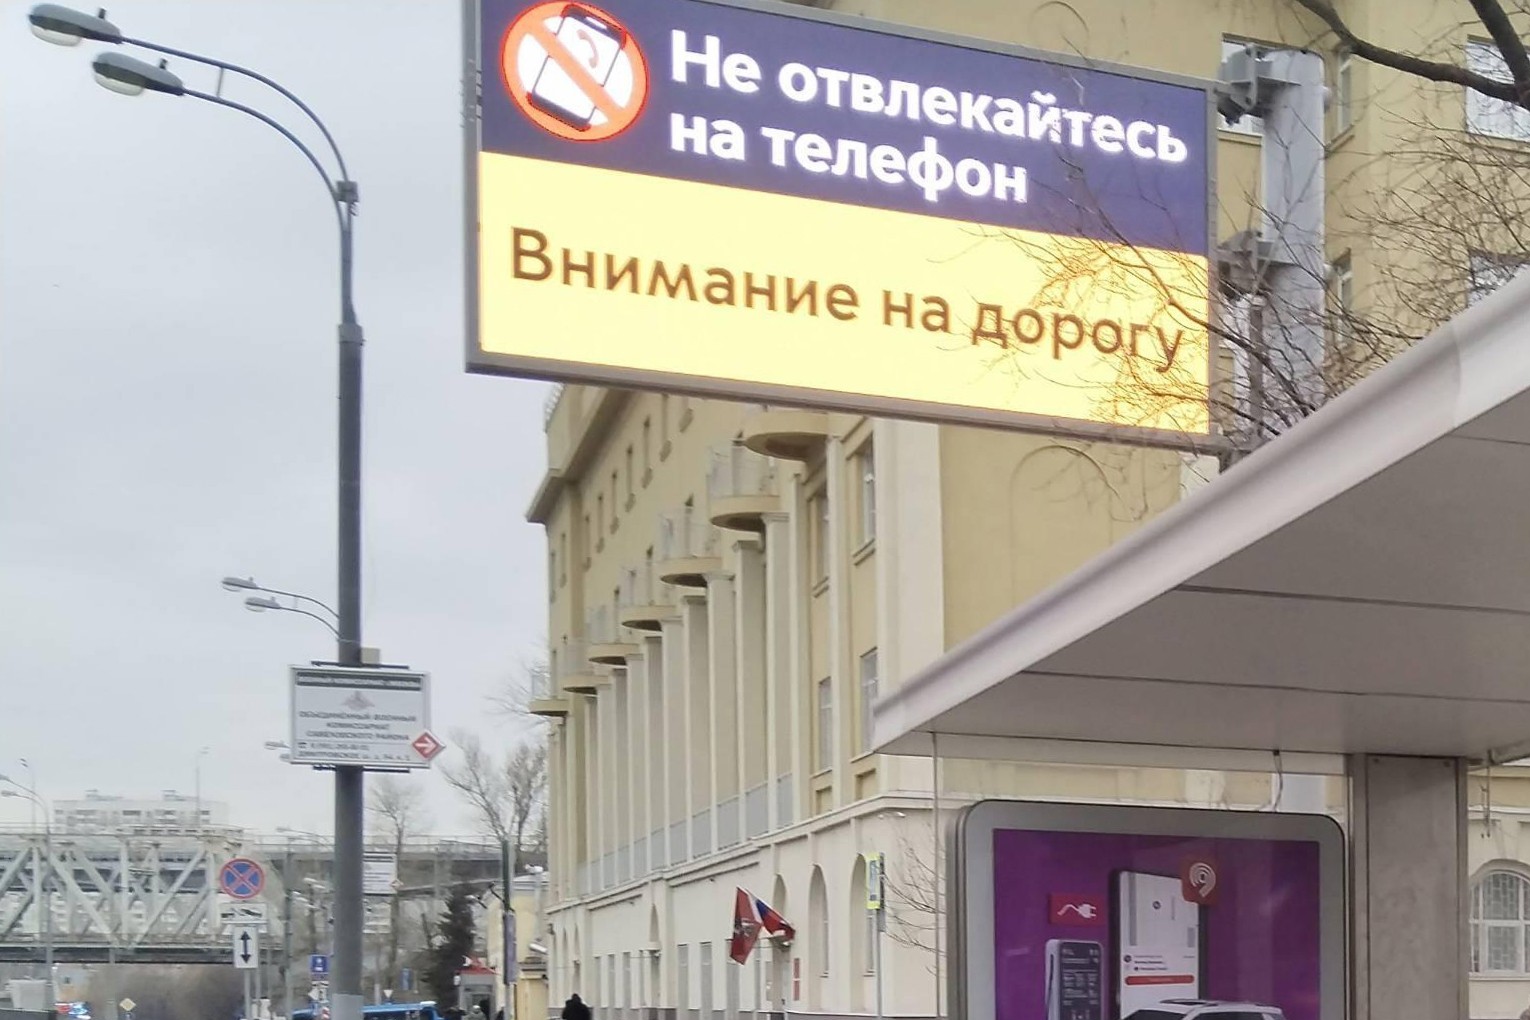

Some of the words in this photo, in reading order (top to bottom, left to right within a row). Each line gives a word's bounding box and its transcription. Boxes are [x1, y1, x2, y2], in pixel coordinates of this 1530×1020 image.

[670, 29, 760, 95] Не
[778, 57, 1188, 164] отвлекайтесь
[670, 110, 746, 161] на
[760, 121, 1028, 204] телефон
[511, 226, 859, 321] Внимание
[882, 288, 951, 335] на
[971, 300, 1185, 374] дорогу
